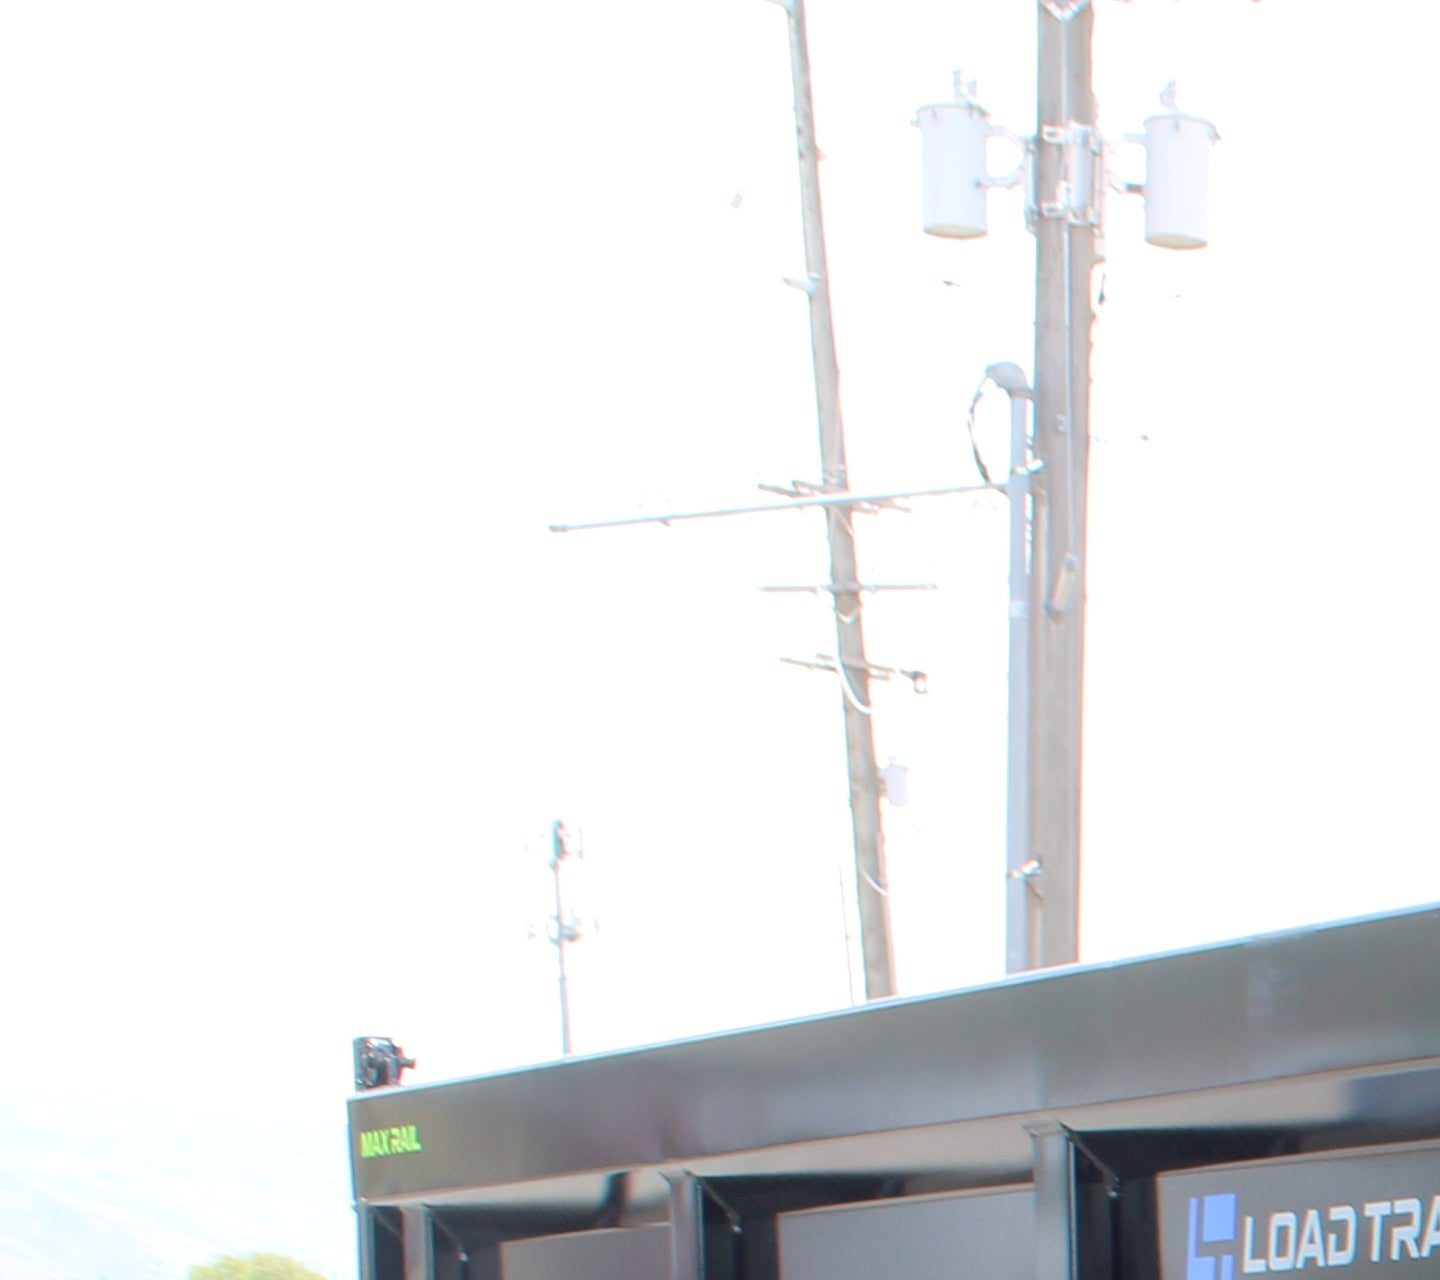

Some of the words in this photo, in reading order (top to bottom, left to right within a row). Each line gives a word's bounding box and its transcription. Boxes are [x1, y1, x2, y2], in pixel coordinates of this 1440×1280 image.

[360, 1128, 390, 1158] MAX
[390, 1124, 424, 1153] RAIL
[1242, 1205, 1359, 1274] LOAD
